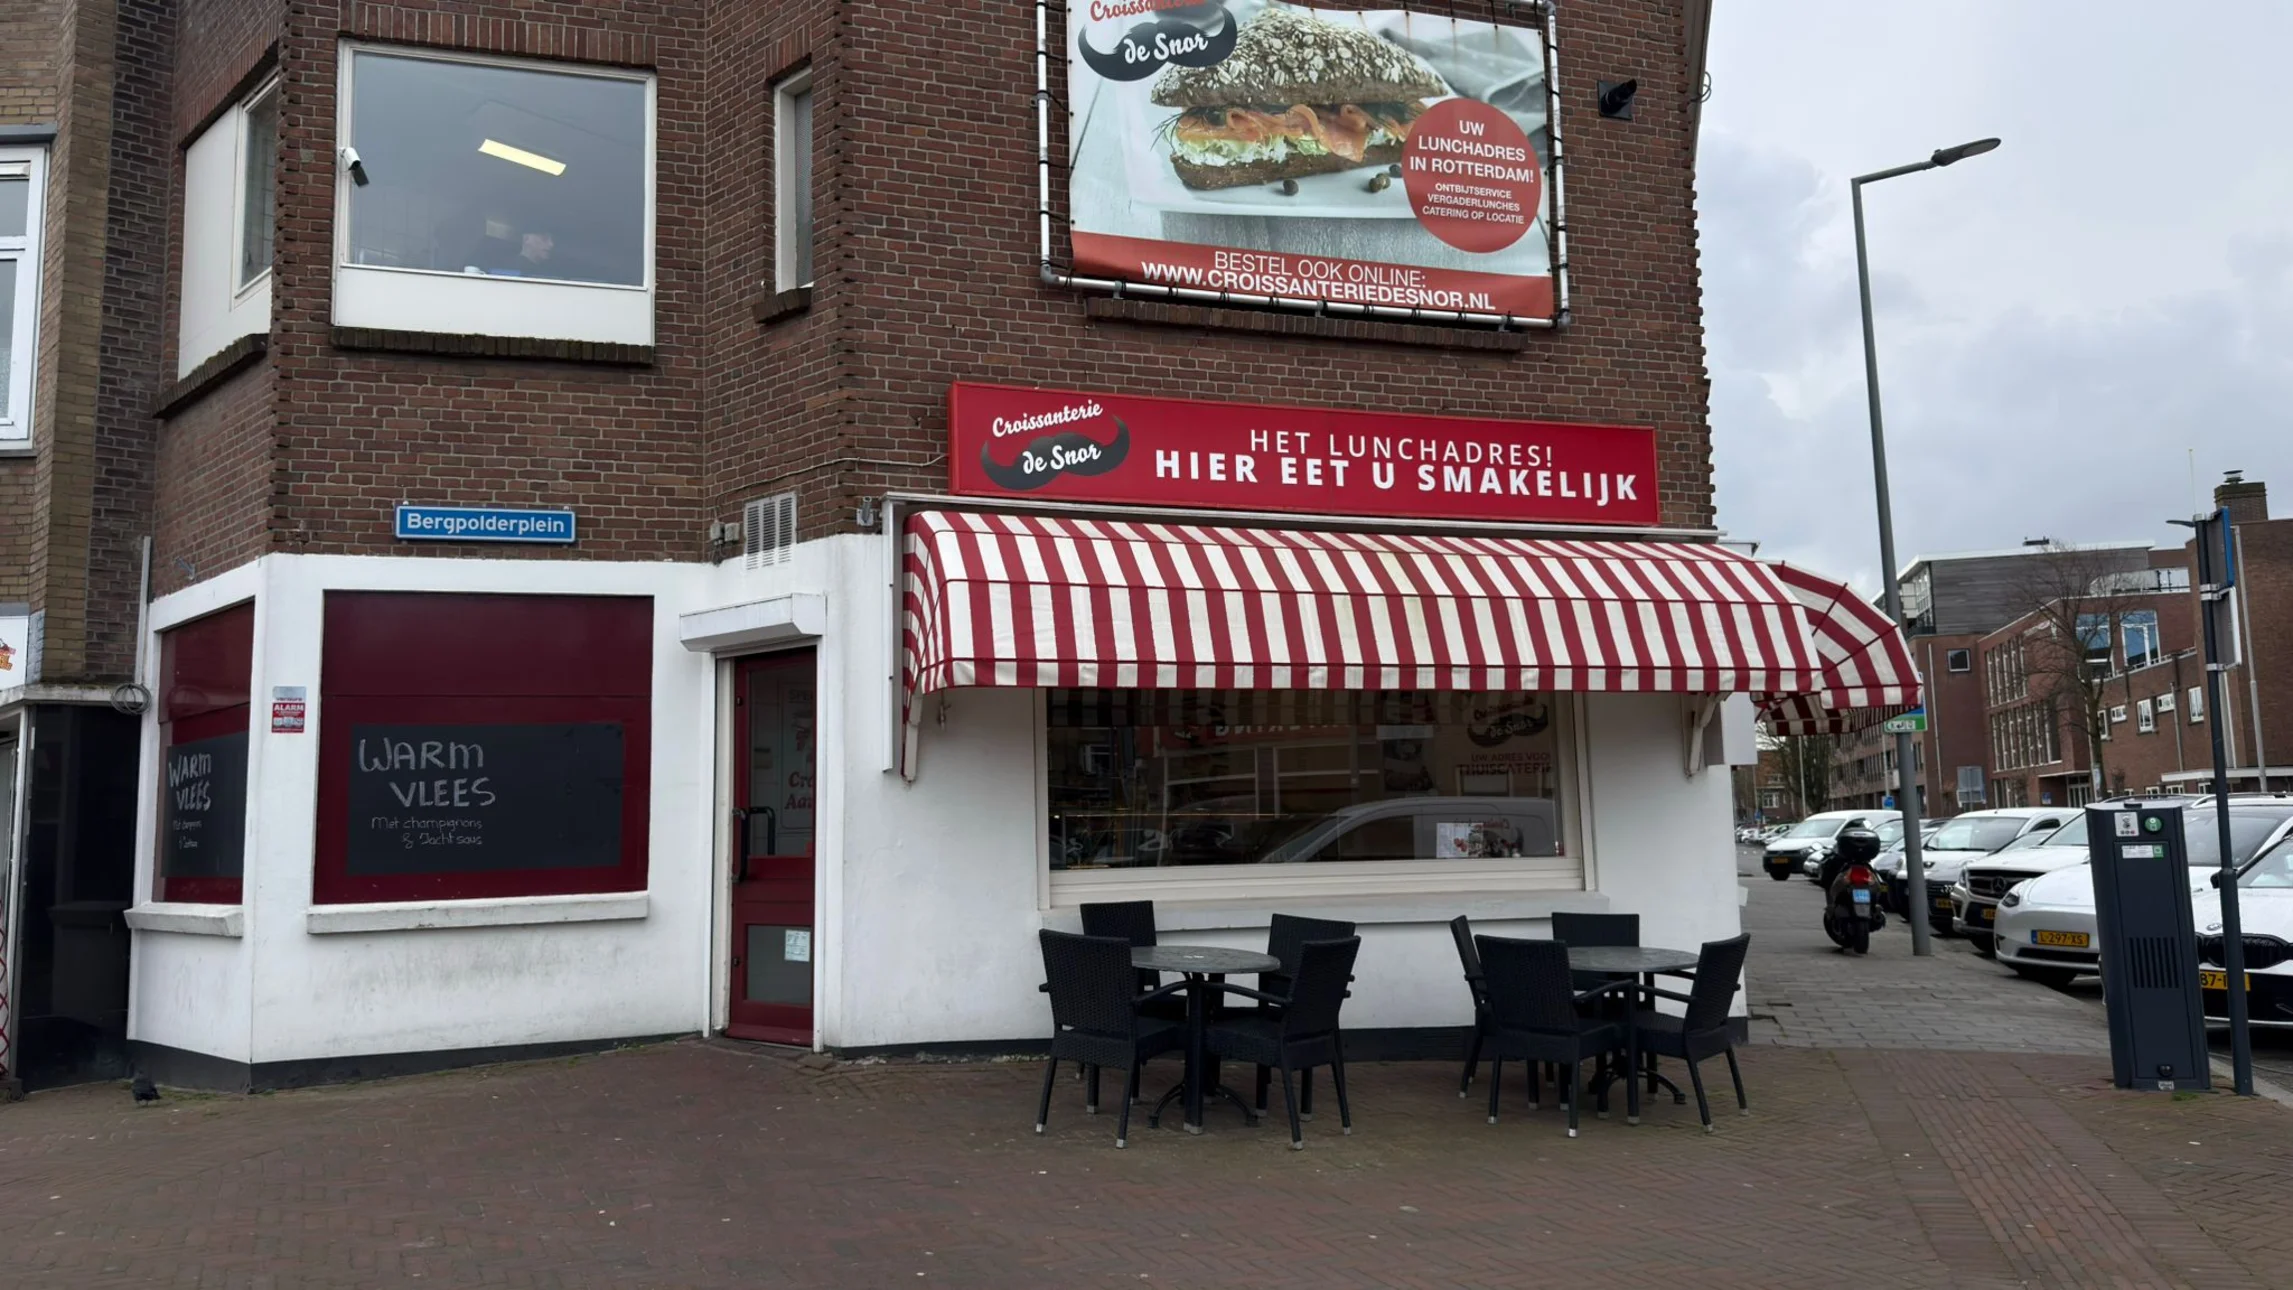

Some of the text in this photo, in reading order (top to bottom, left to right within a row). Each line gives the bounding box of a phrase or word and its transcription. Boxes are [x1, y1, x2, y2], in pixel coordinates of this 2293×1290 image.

[1123, 32, 1209, 65] de Snor
[1459, 120, 1485, 136] UW
[1418, 135, 1526, 162] LUNCHADRES
[1410, 156, 1534, 183] IN ROTTERDAM!
[1427, 193, 1520, 212] VERGADERLUNCHES
[1435, 182, 1512, 199] ONTBIJTSERVICE
[1422, 205, 1525, 224] CATERING OP LOCATIE
[1214, 251, 1426, 288] BESTEL OOK ONLINE:
[1141, 261, 1496, 311] WWW.CROISSANTERIEDESNOR.NL
[992, 398, 1103, 438] Croissanterie
[1022, 443, 1101, 475] de Snor
[1251, 429, 1553, 468] HET LUNCHADRES!
[1156, 449, 1637, 507] HIER EET U SMAKELIJK
[407, 513, 565, 536] Bergpolderplein
[273, 704, 304, 712] ALARM
[168, 752, 212, 788] WARM
[358, 737, 484, 772] WARM
[1525, 751, 1552, 763] VOO
[175, 780, 212, 812] VLEES
[389, 777, 496, 808] VLEES
[371, 816, 400, 830] Met
